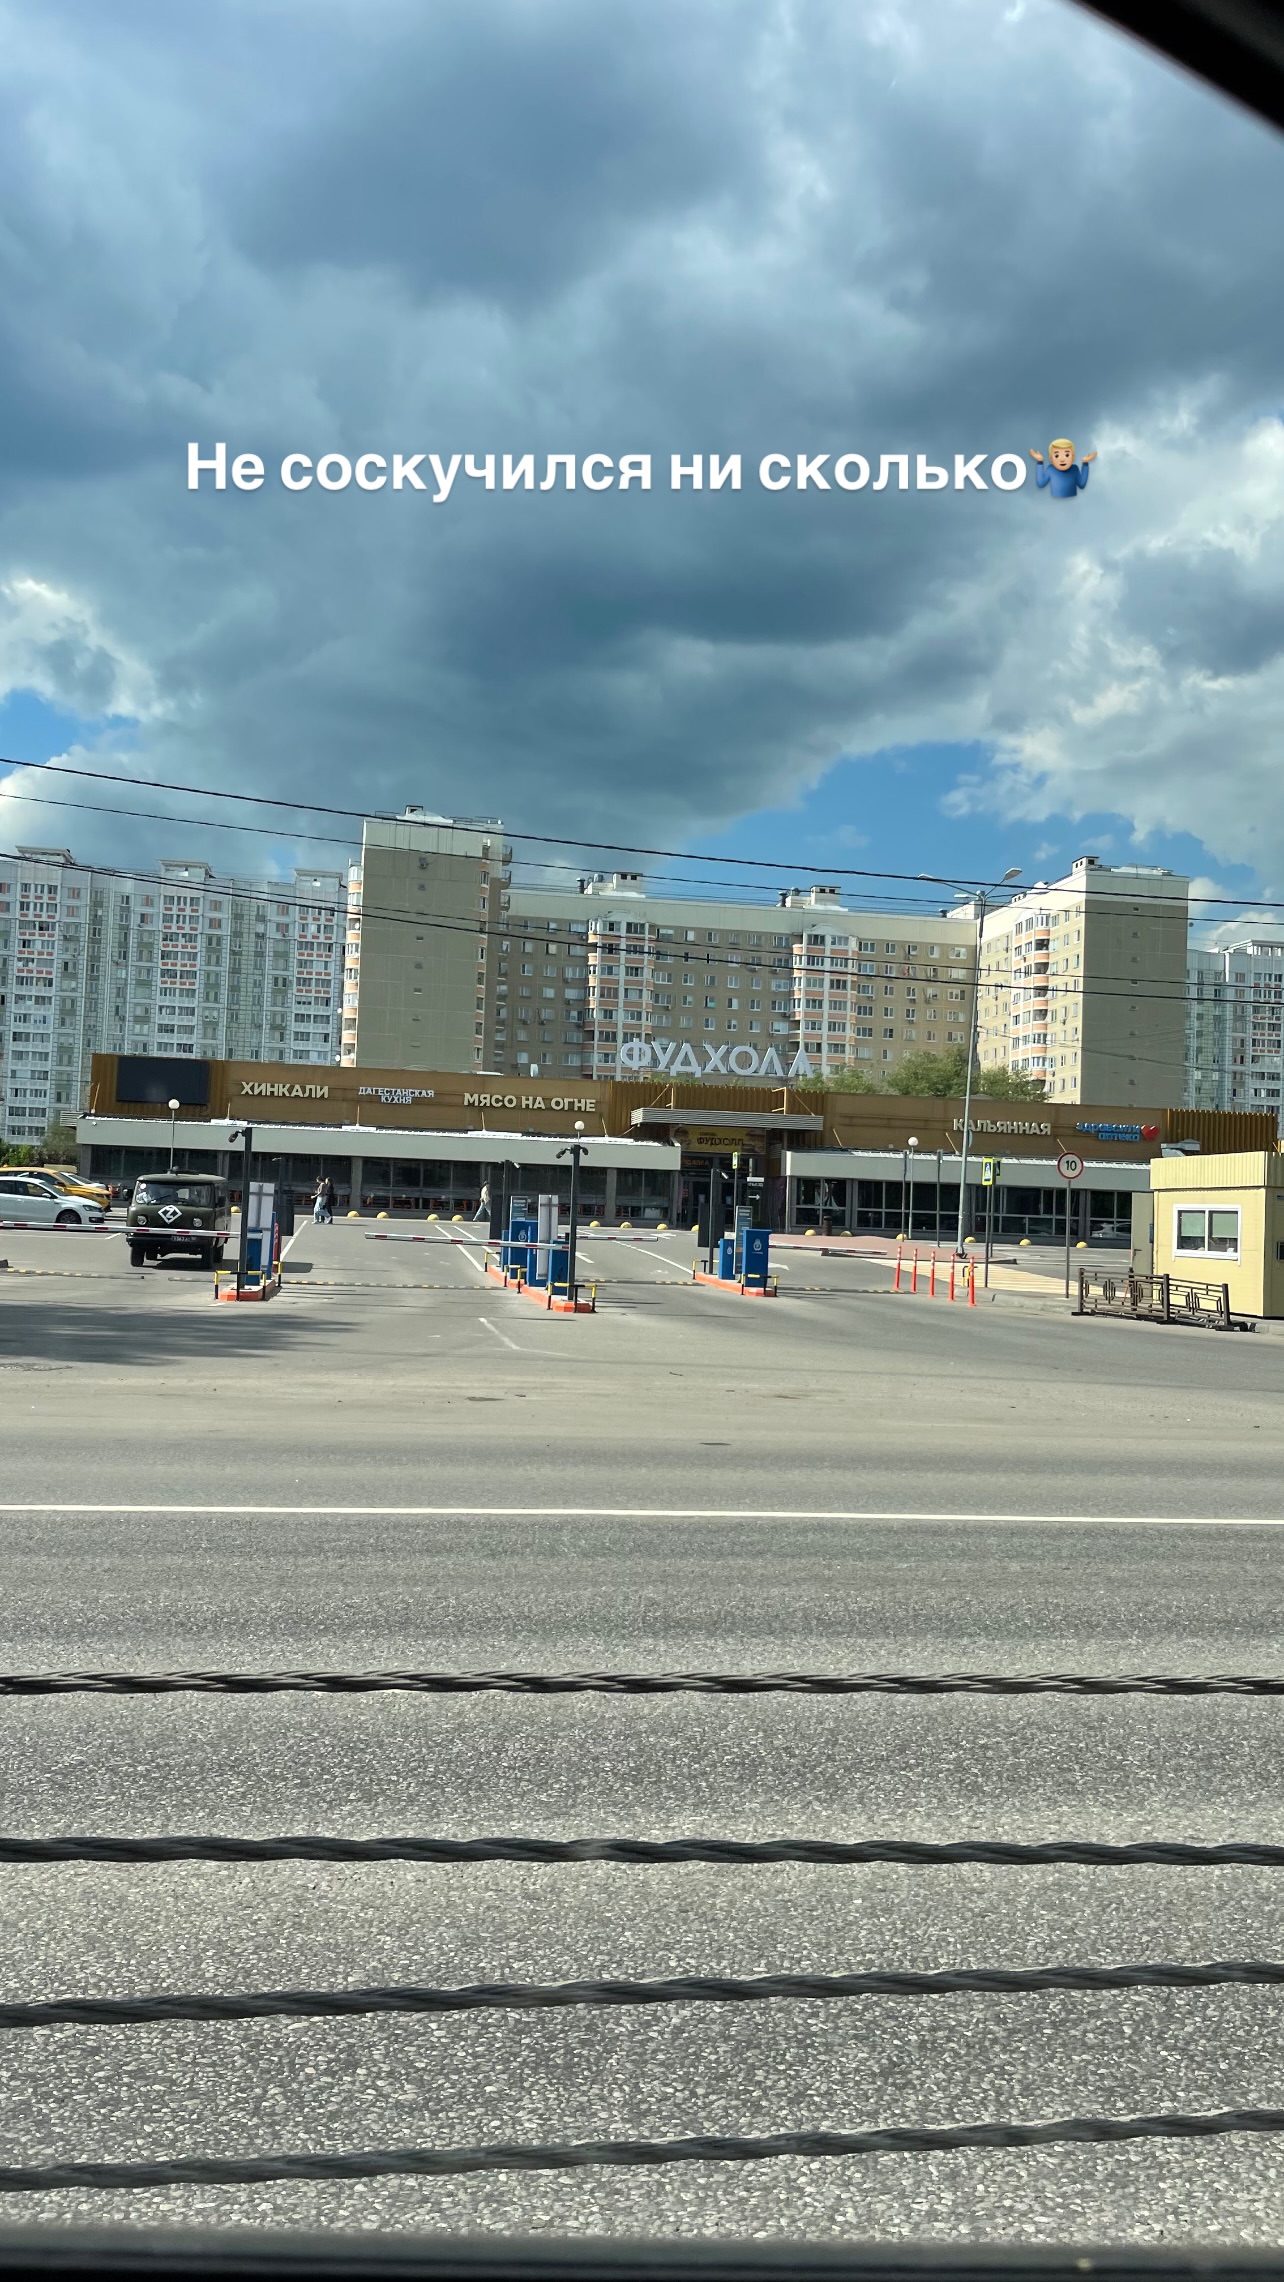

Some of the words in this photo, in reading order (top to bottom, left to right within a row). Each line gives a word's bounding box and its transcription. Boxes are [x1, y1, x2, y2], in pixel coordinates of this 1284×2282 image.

[620, 1037, 815, 1079] ФУДХОЛЛ
[240, 1081, 329, 1099] ХИНКАЛИ
[358, 1086, 434, 1098] ДАГЕСТАНСКАЯ
[380, 1096, 412, 1104] КУХНЯ
[463, 1092, 517, 1108] МЯСО
[521, 1095, 546, 1110] НА
[550, 1097, 597, 1112] ОГНЕ
[953, 1118, 1052, 1136] КАЛЬЯННАЯ
[1065, 1160, 1077, 1171] 10
